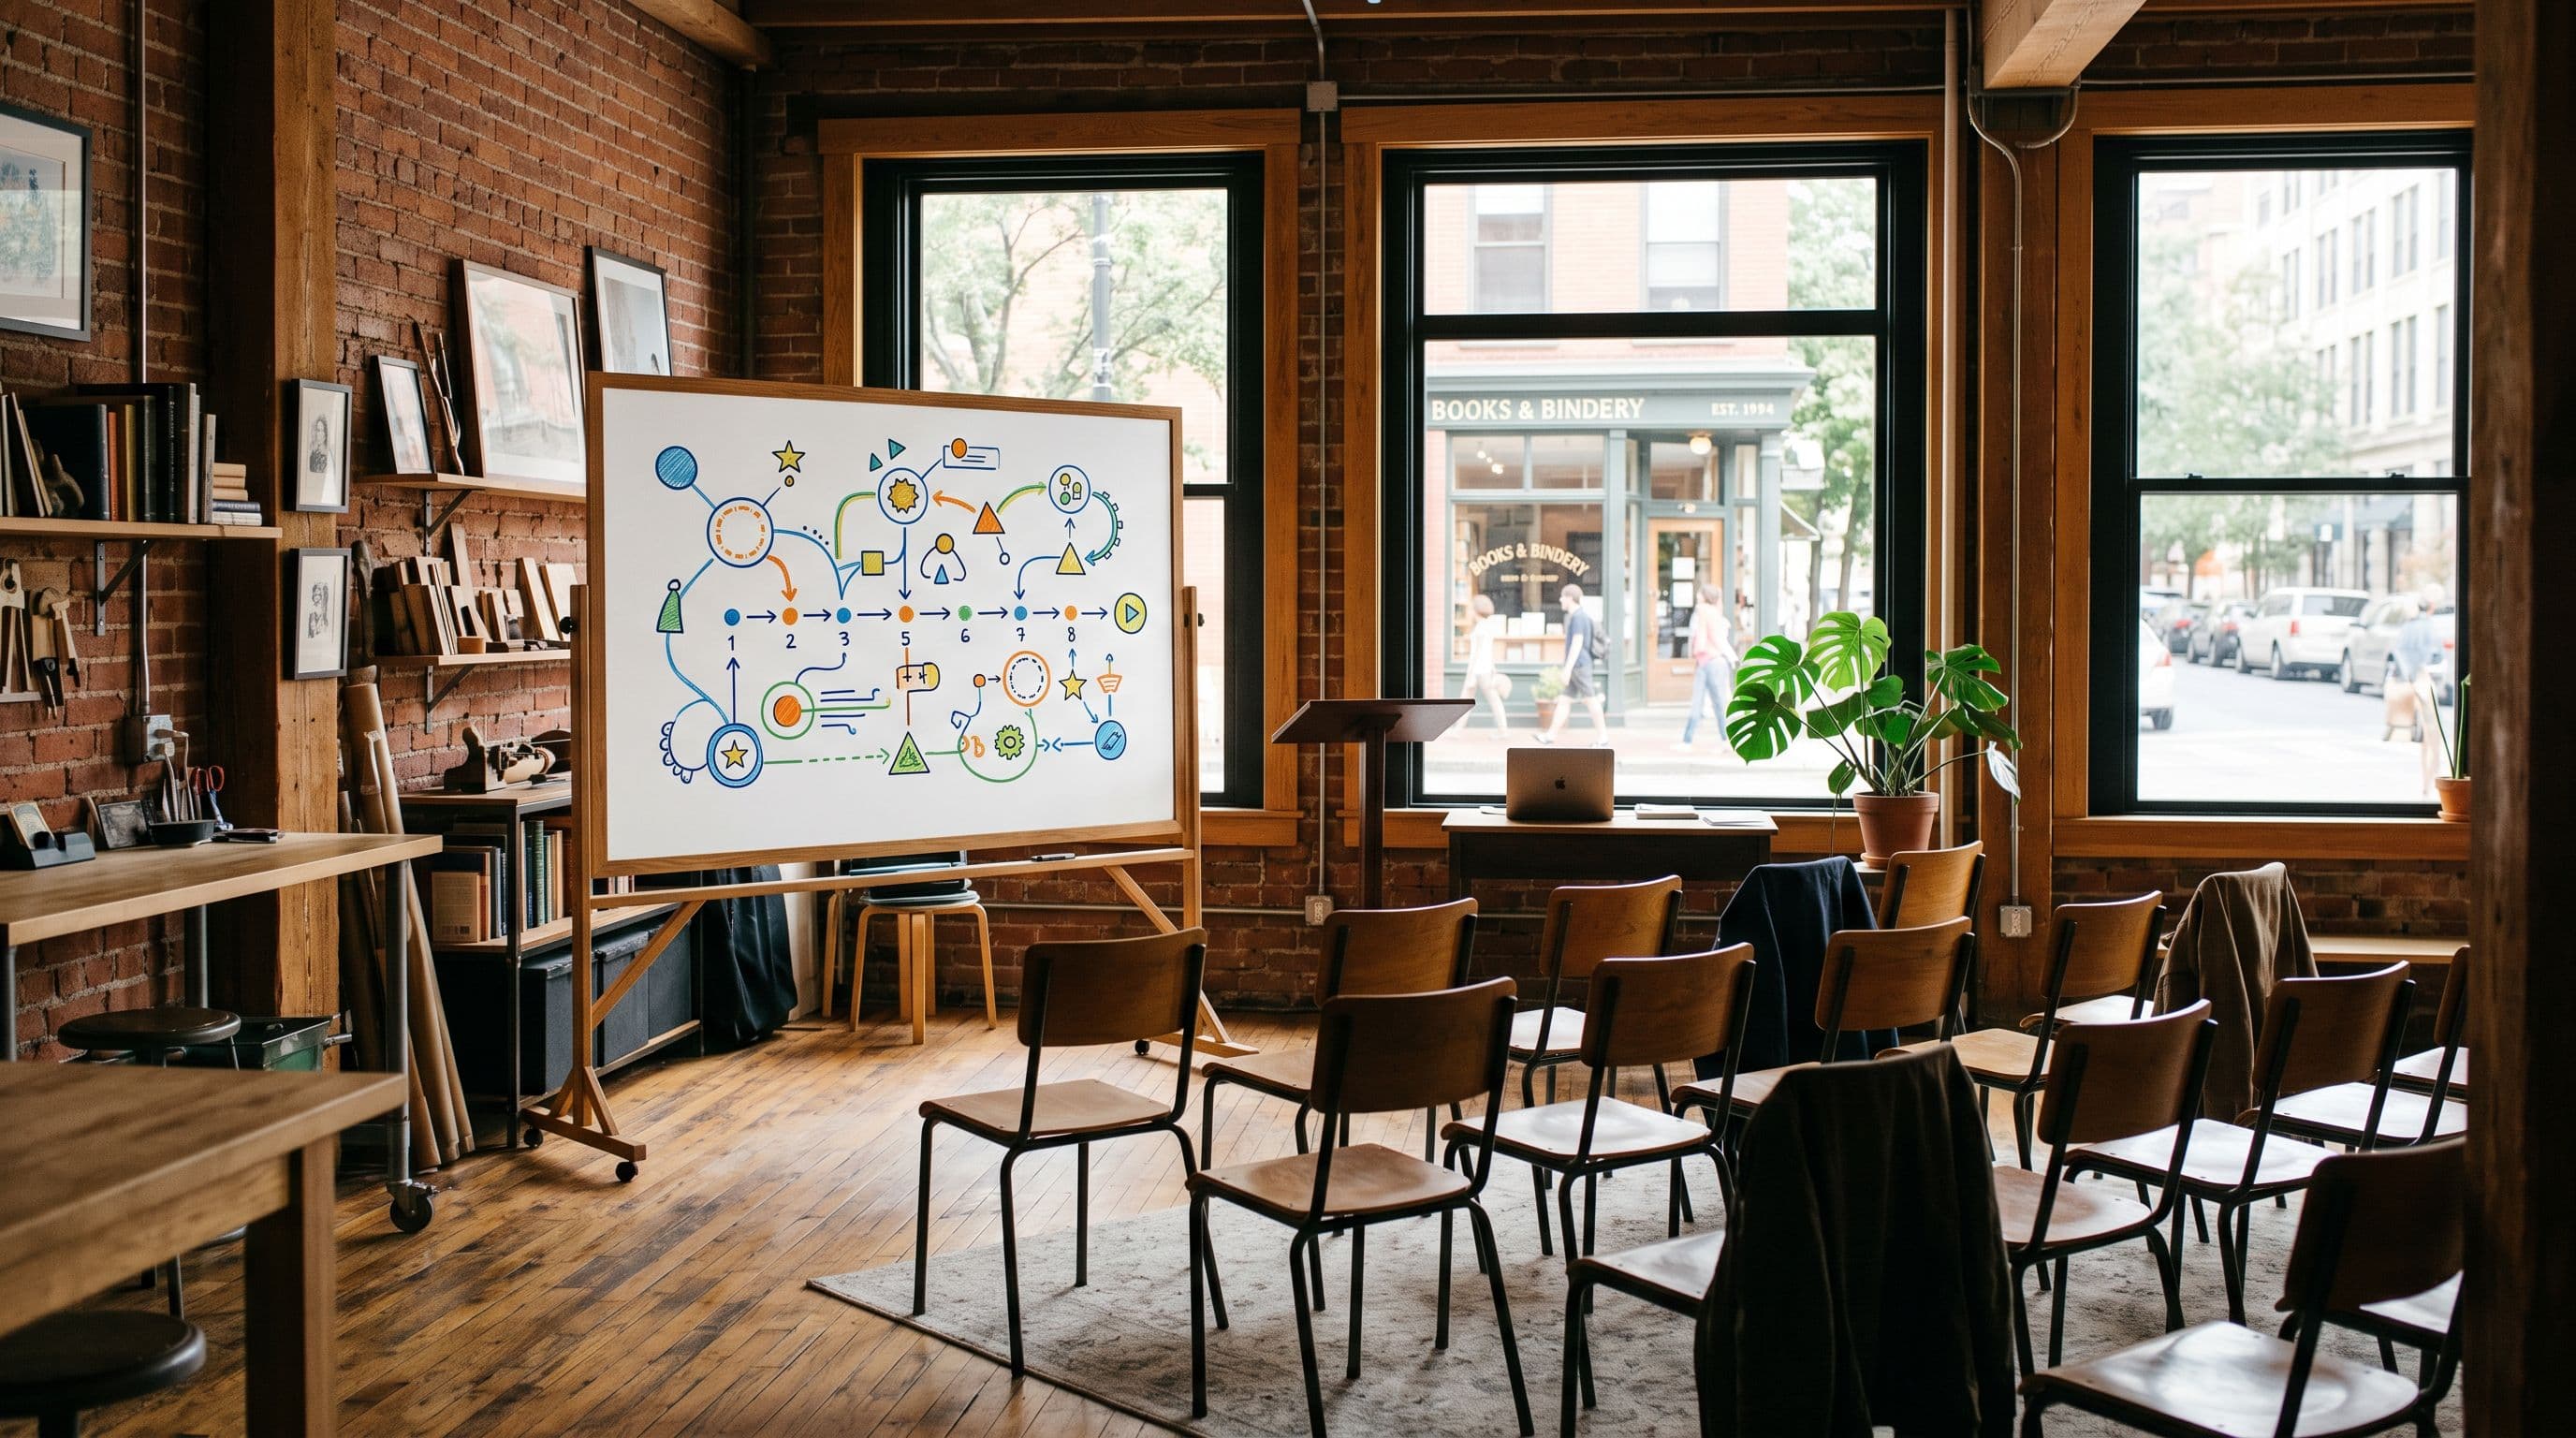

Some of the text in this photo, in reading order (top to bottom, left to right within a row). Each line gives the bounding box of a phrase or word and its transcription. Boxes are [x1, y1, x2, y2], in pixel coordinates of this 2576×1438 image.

[1431, 398, 1645, 420] BOOKS & BINDERY
[1711, 403, 1738, 416] EST.
[1469, 543, 1590, 577] BOOKS & BINDERY
[727, 626, 1076, 651] 1 2 3 5 6 7 8
